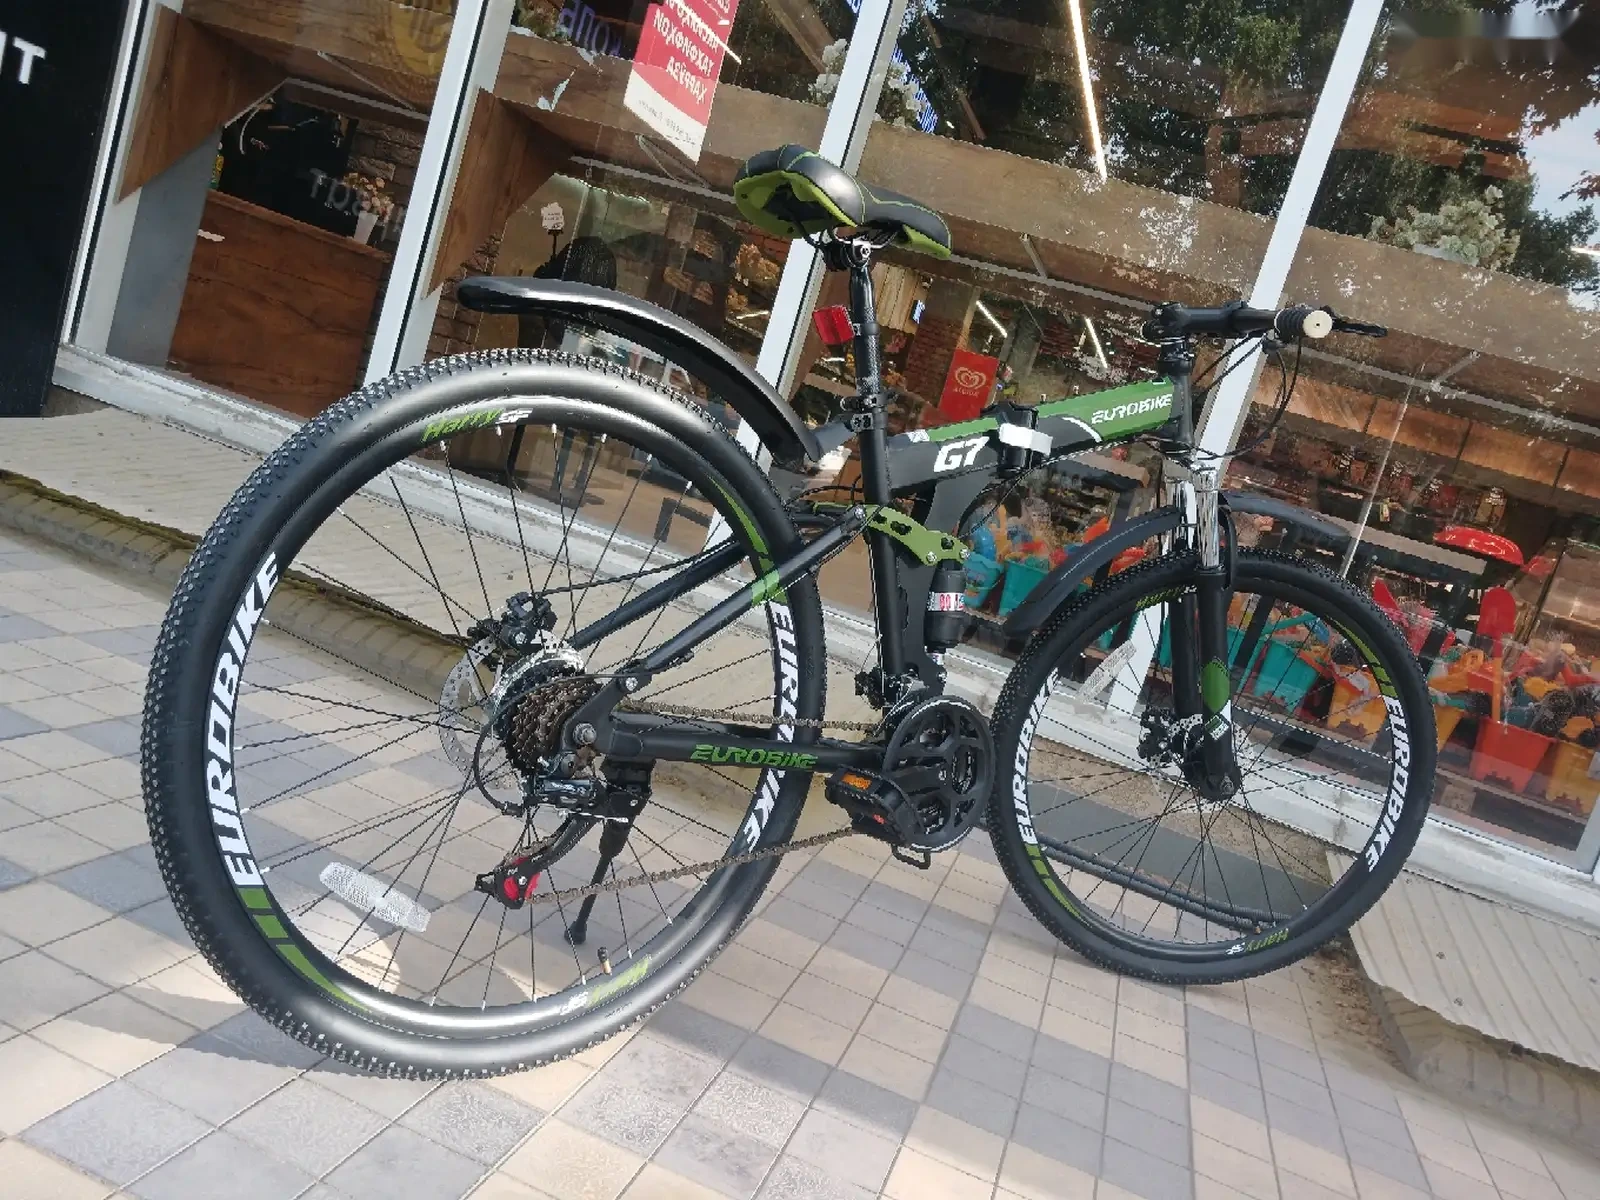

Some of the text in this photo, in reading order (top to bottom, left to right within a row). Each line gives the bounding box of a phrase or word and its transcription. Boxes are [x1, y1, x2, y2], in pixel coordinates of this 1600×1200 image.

[933, 435, 990, 472] G7
[1091, 393, 1173, 424] EUROBIKE
[207, 551, 280, 886] EUROBIKE
[690, 744, 818, 769] EUROBIKE
[1012, 667, 1059, 845] EUROBIKE
[1365, 695, 1411, 872] EUROBIKE
